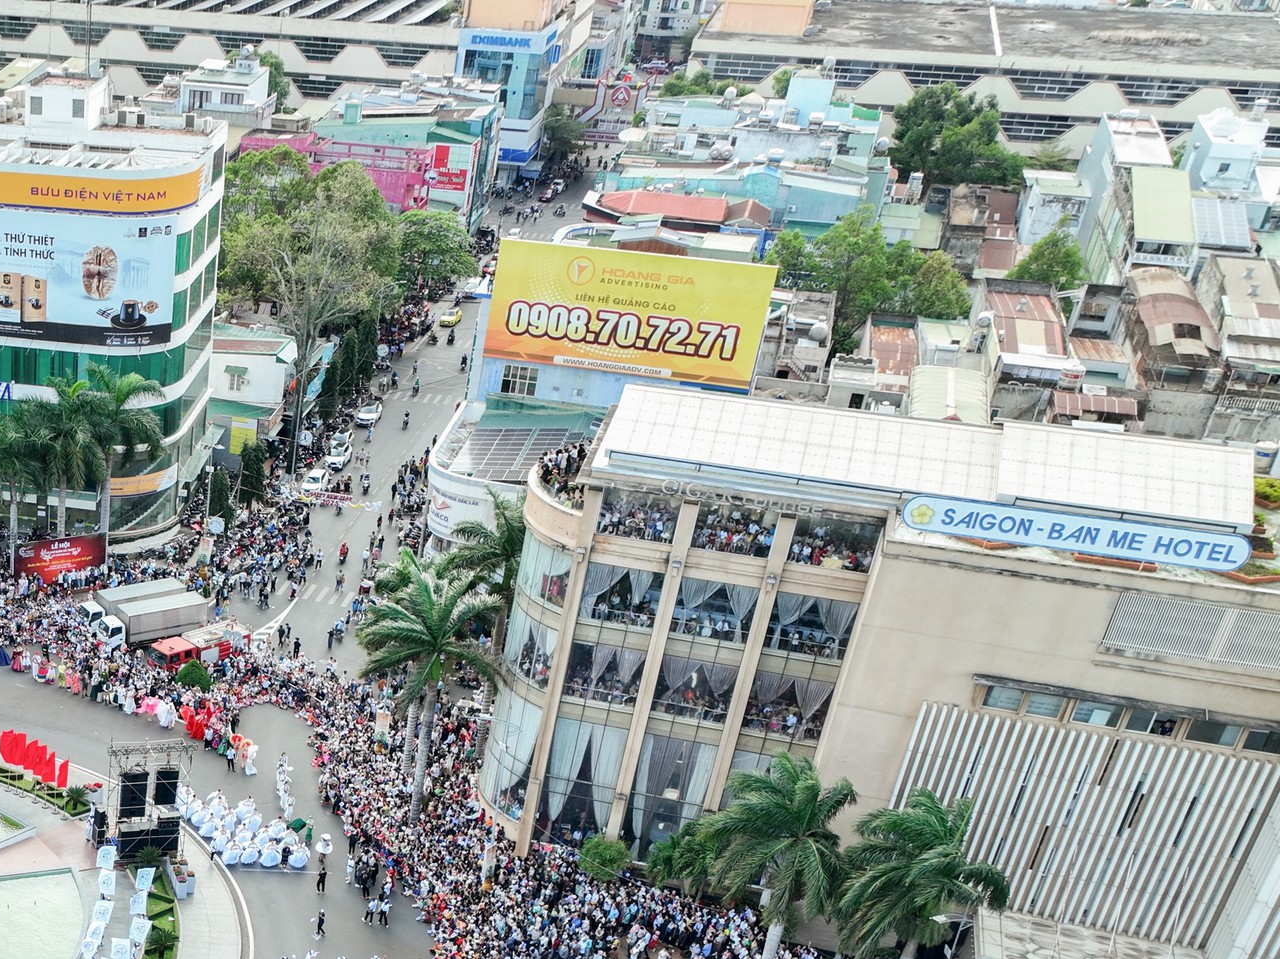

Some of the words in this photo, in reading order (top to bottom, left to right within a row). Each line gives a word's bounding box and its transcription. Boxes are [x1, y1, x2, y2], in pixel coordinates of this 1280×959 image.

[471, 34, 532, 48] EXIMBANK
[30, 186, 60, 197] BƯU
[64, 187, 98, 202] ĐIỆN
[102, 190, 133, 204] VIỆT
[136, 191, 167, 201] NAM
[4, 232, 26, 243] THỨ
[28, 234, 55, 247] THIỆT
[4, 244, 27, 257] TỈNH
[29, 248, 55, 260] THỨC
[600, 277, 669, 291] ADVERTISING
[601, 267, 662, 282] HOANG
[667, 274, 696, 286] GIA
[575, 292, 595, 302] LIÊN
[597, 295, 610, 304] HỆ
[613, 296, 650, 308] QUẢNG
[653, 301, 676, 312] CÁO
[506, 301, 740, 361] 0908.70.72.71
[562, 357, 662, 376] WWW.HOANGGIAADV.COM
[661, 479, 734, 504] CIGAR
[741, 494, 824, 515] LOUNGE
[941, 508, 1032, 536] SAIGON
[1047, 522, 1100, 546] BAN
[1106, 529, 1147, 552] ME
[1152, 535, 1240, 565] HOTEL
[51, 542, 58, 550] LỄ
